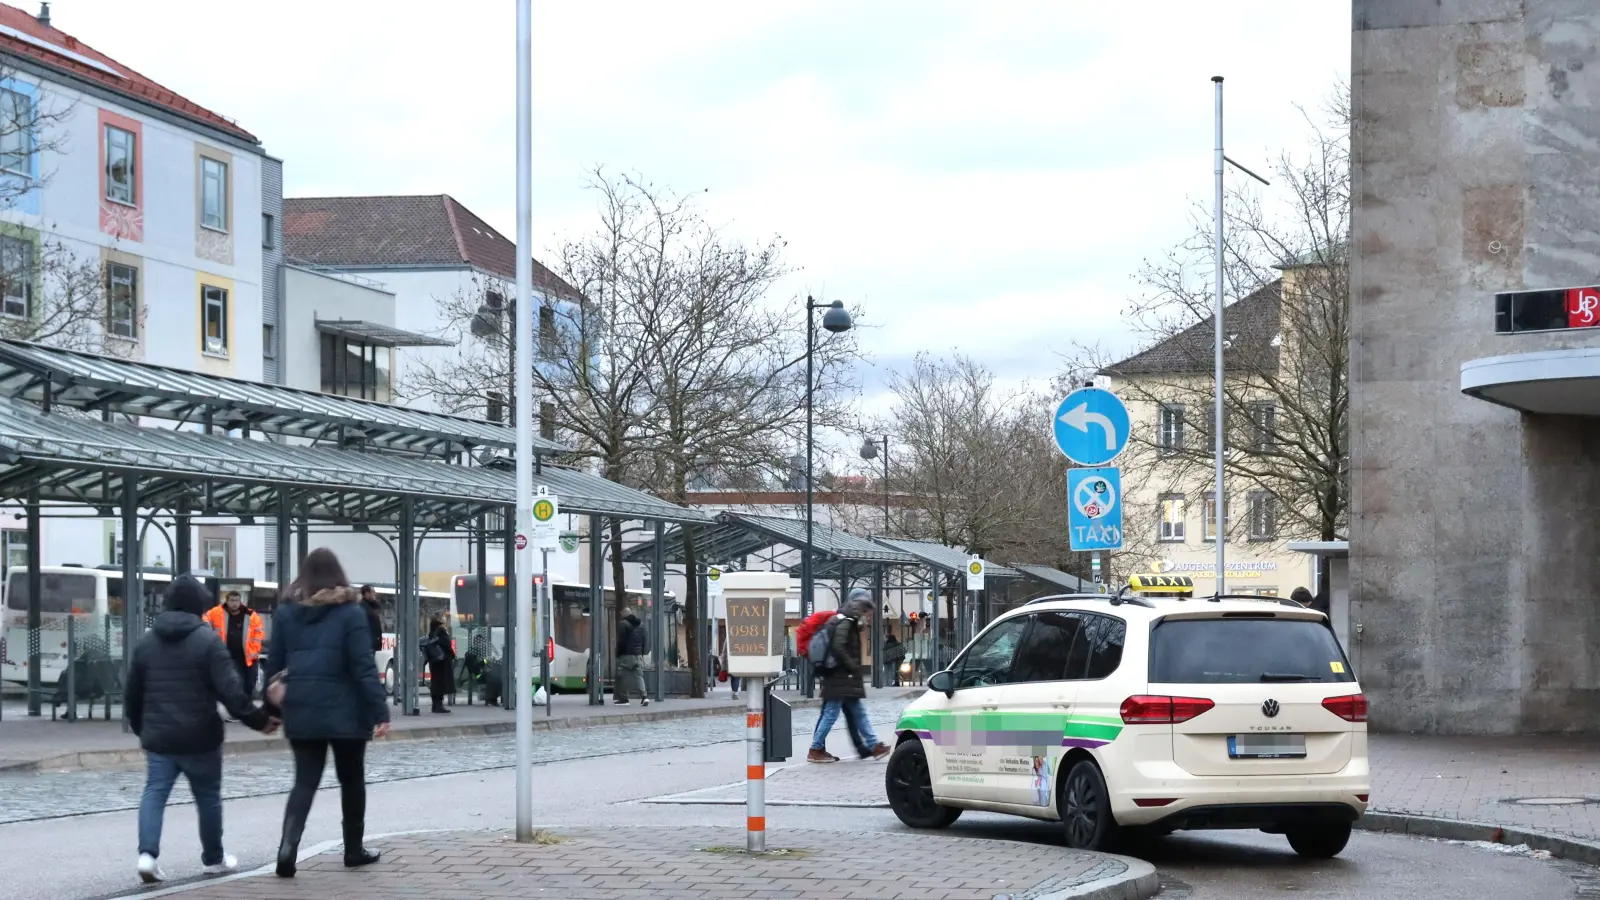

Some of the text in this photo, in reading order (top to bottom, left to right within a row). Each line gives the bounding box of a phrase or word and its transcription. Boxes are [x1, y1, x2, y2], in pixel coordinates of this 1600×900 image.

[540, 487, 546, 495] 4
[1075, 524, 1117, 544] TAXI
[1144, 576, 1187, 586] TAXI
[729, 605, 766, 617] TAXI
[729, 624, 766, 637] 0981
[732, 643, 766, 653] 5005
